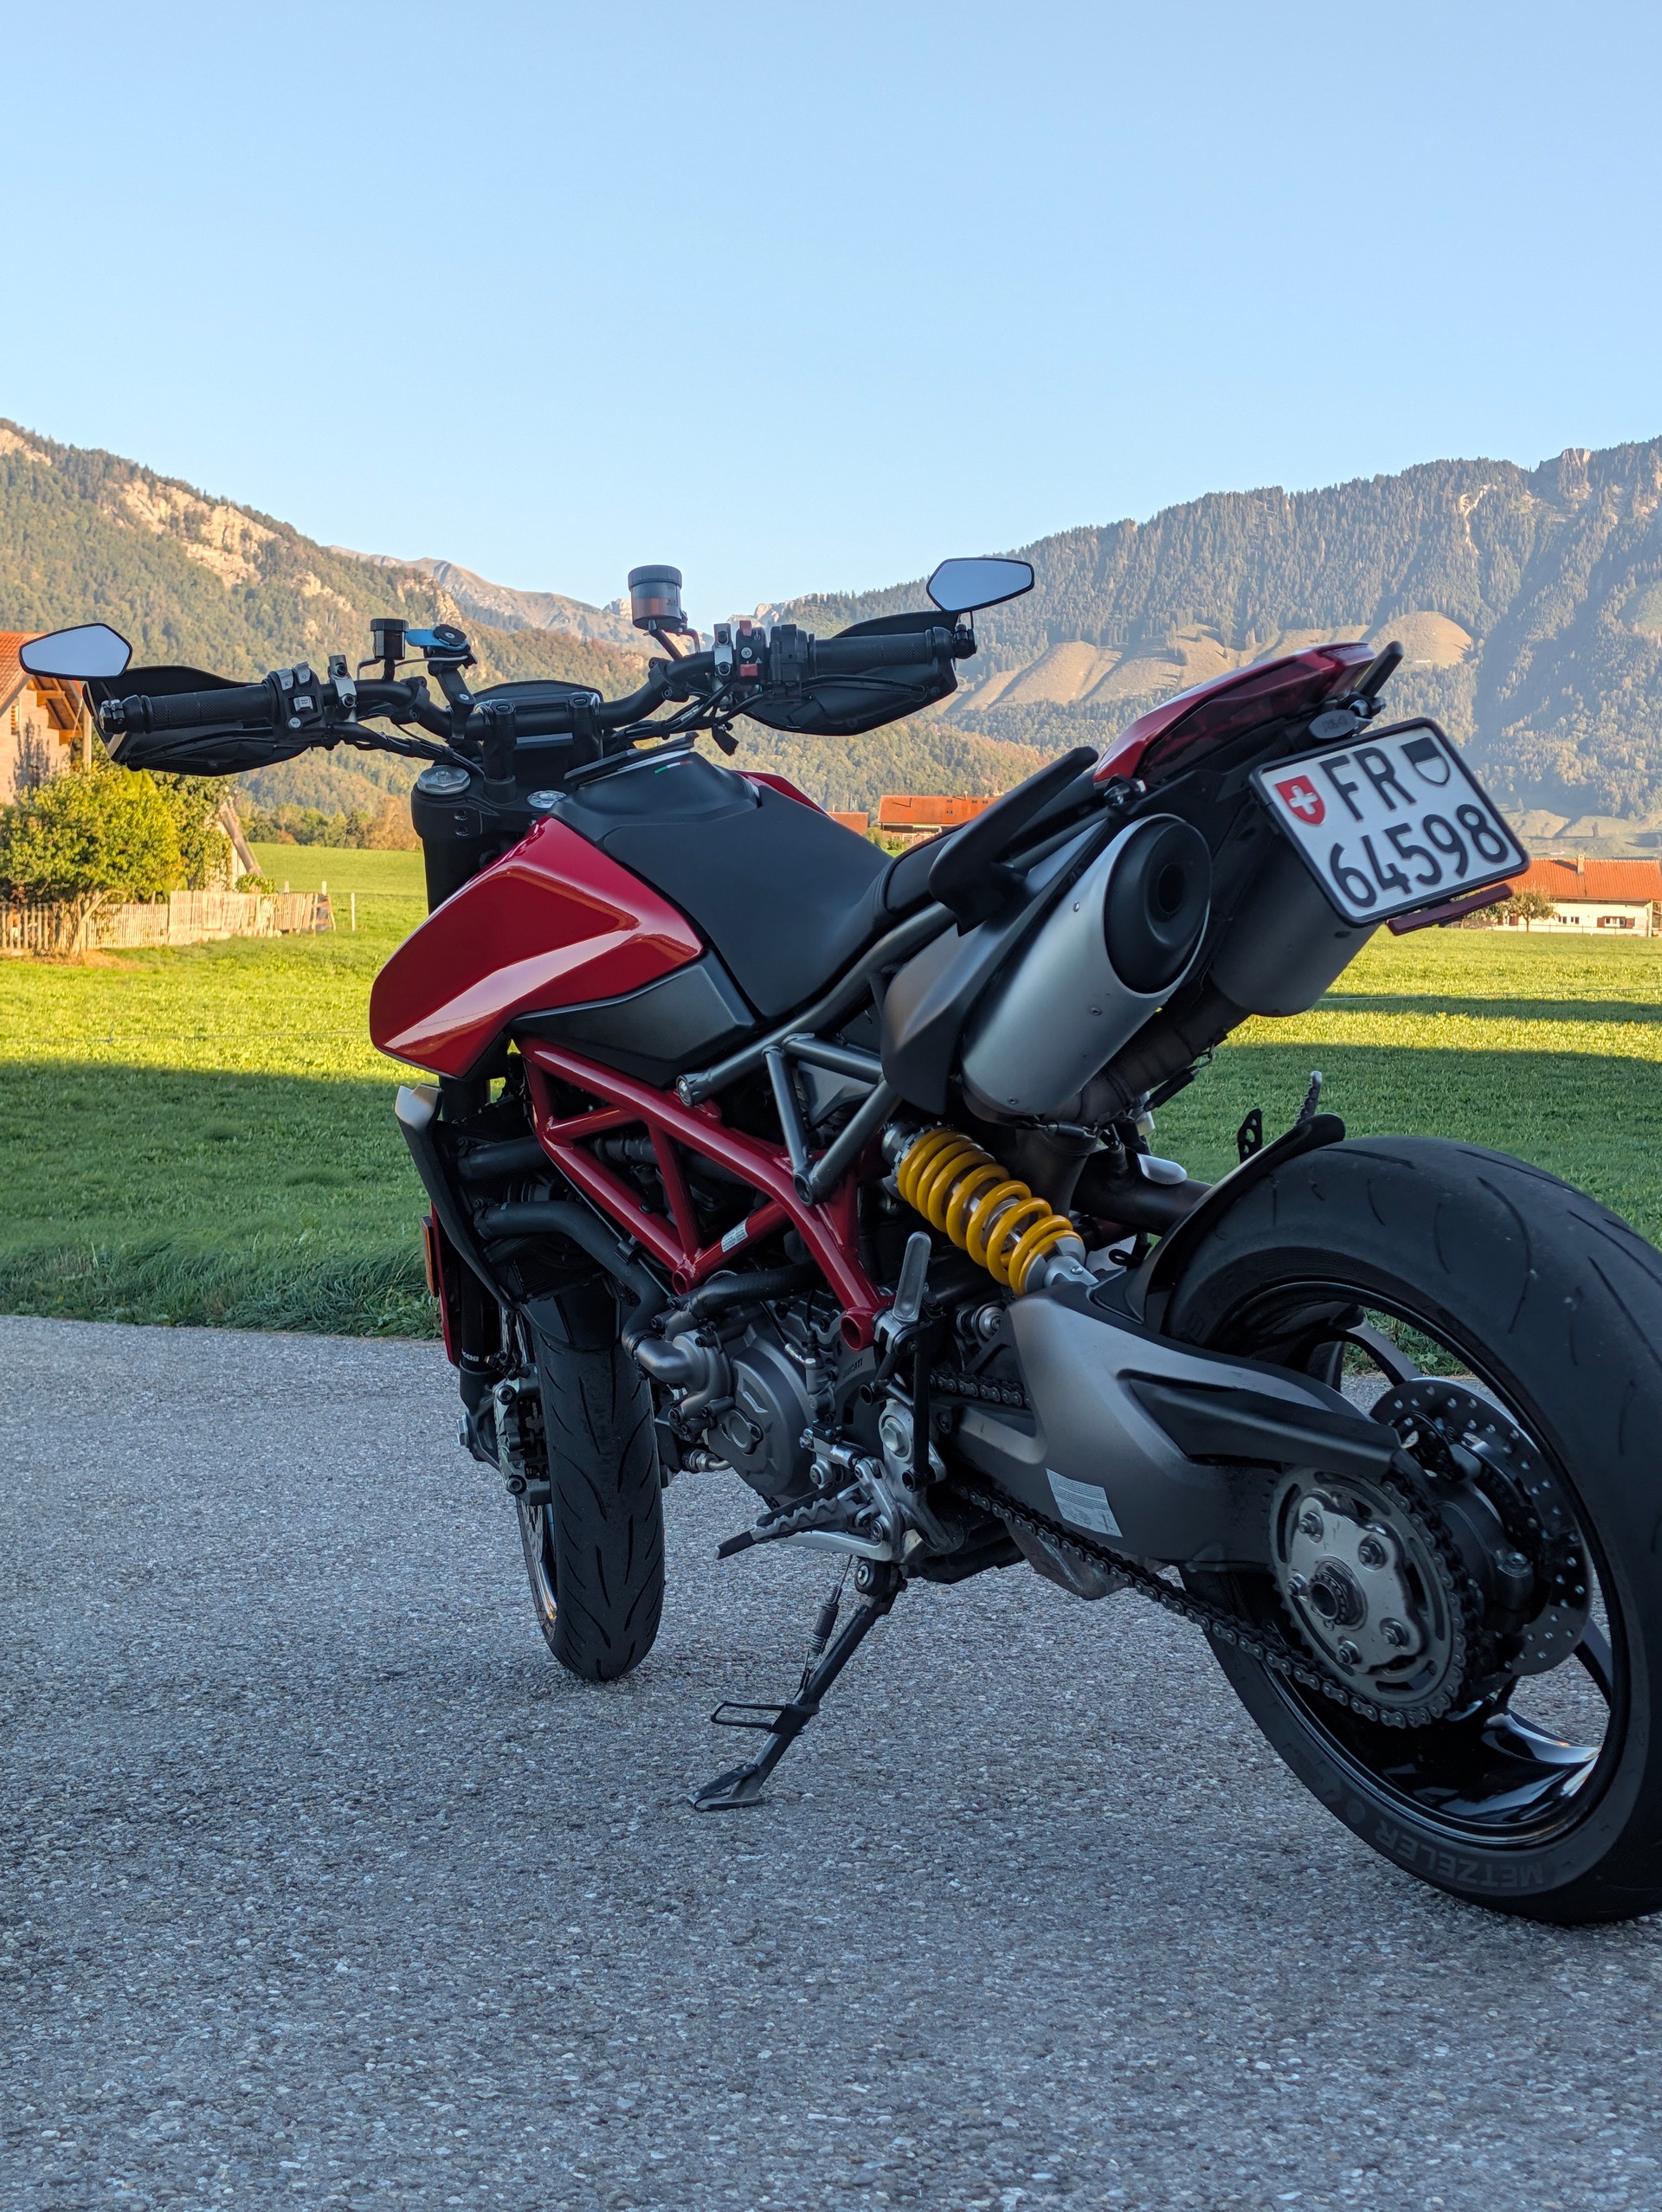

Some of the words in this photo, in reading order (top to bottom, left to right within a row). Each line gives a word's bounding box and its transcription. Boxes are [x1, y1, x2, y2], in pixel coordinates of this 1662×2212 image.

[1318, 746, 1417, 821] FR
[1330, 803, 1510, 909] 64598
[1374, 1820, 1545, 1888] METZELER
